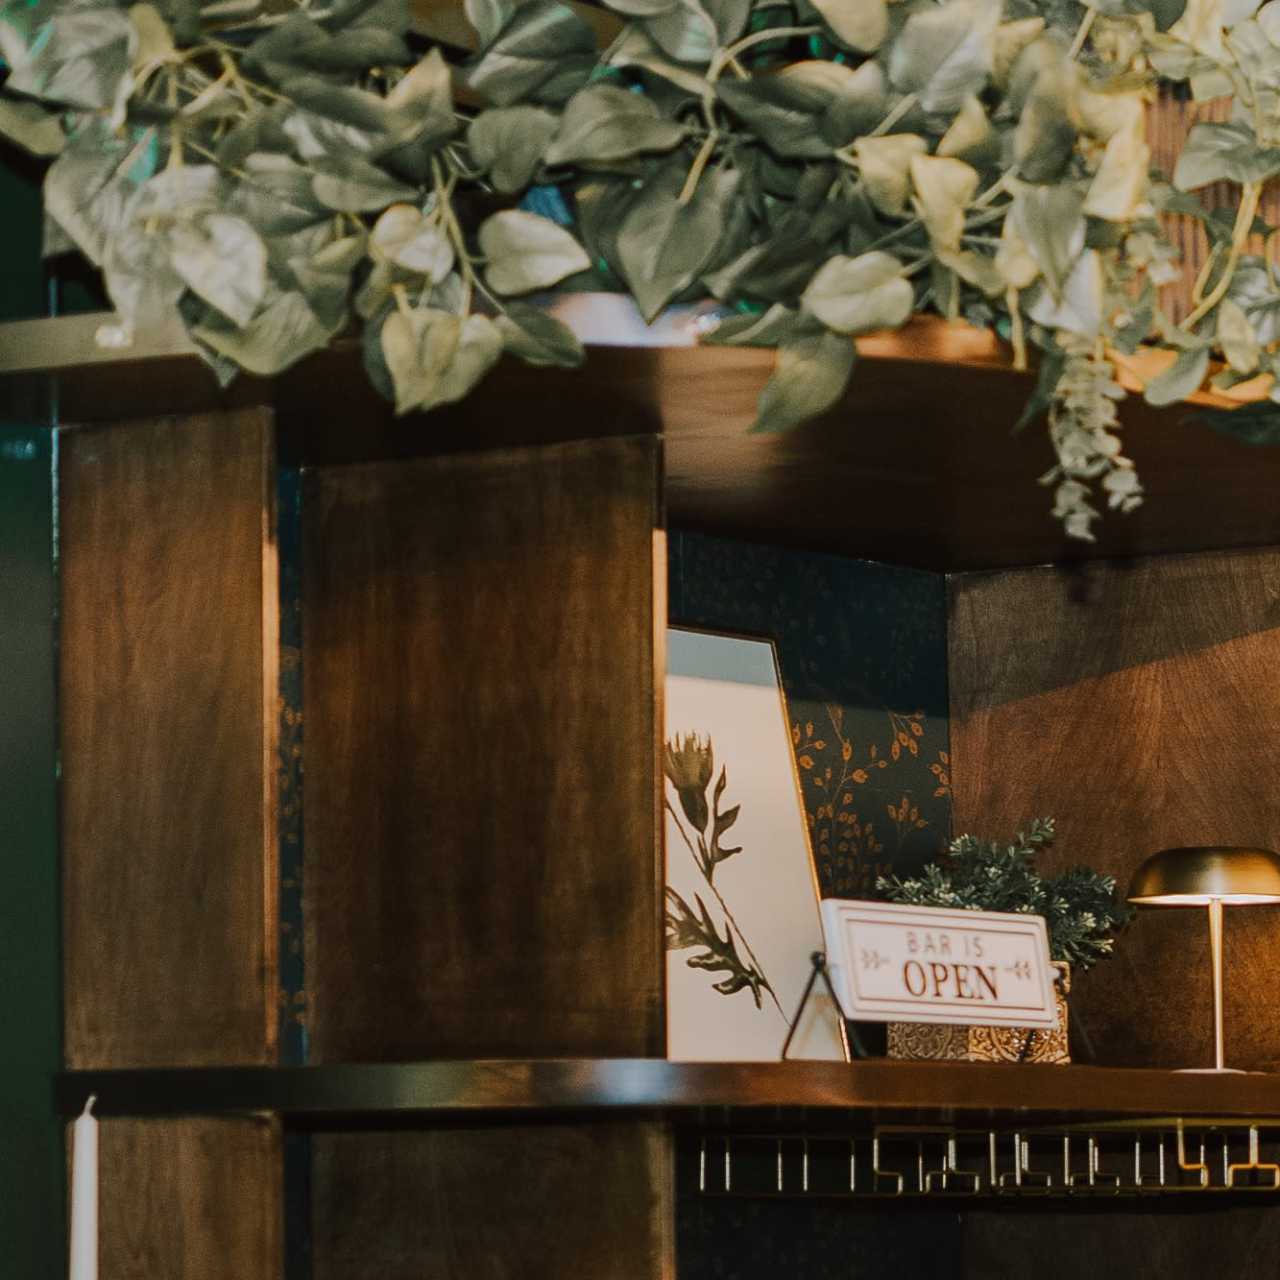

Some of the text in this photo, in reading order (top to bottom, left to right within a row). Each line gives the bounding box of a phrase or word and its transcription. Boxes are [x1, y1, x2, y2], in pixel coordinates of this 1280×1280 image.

[907, 931, 985, 959] BAR IS
[903, 959, 998, 1001] OPEN
